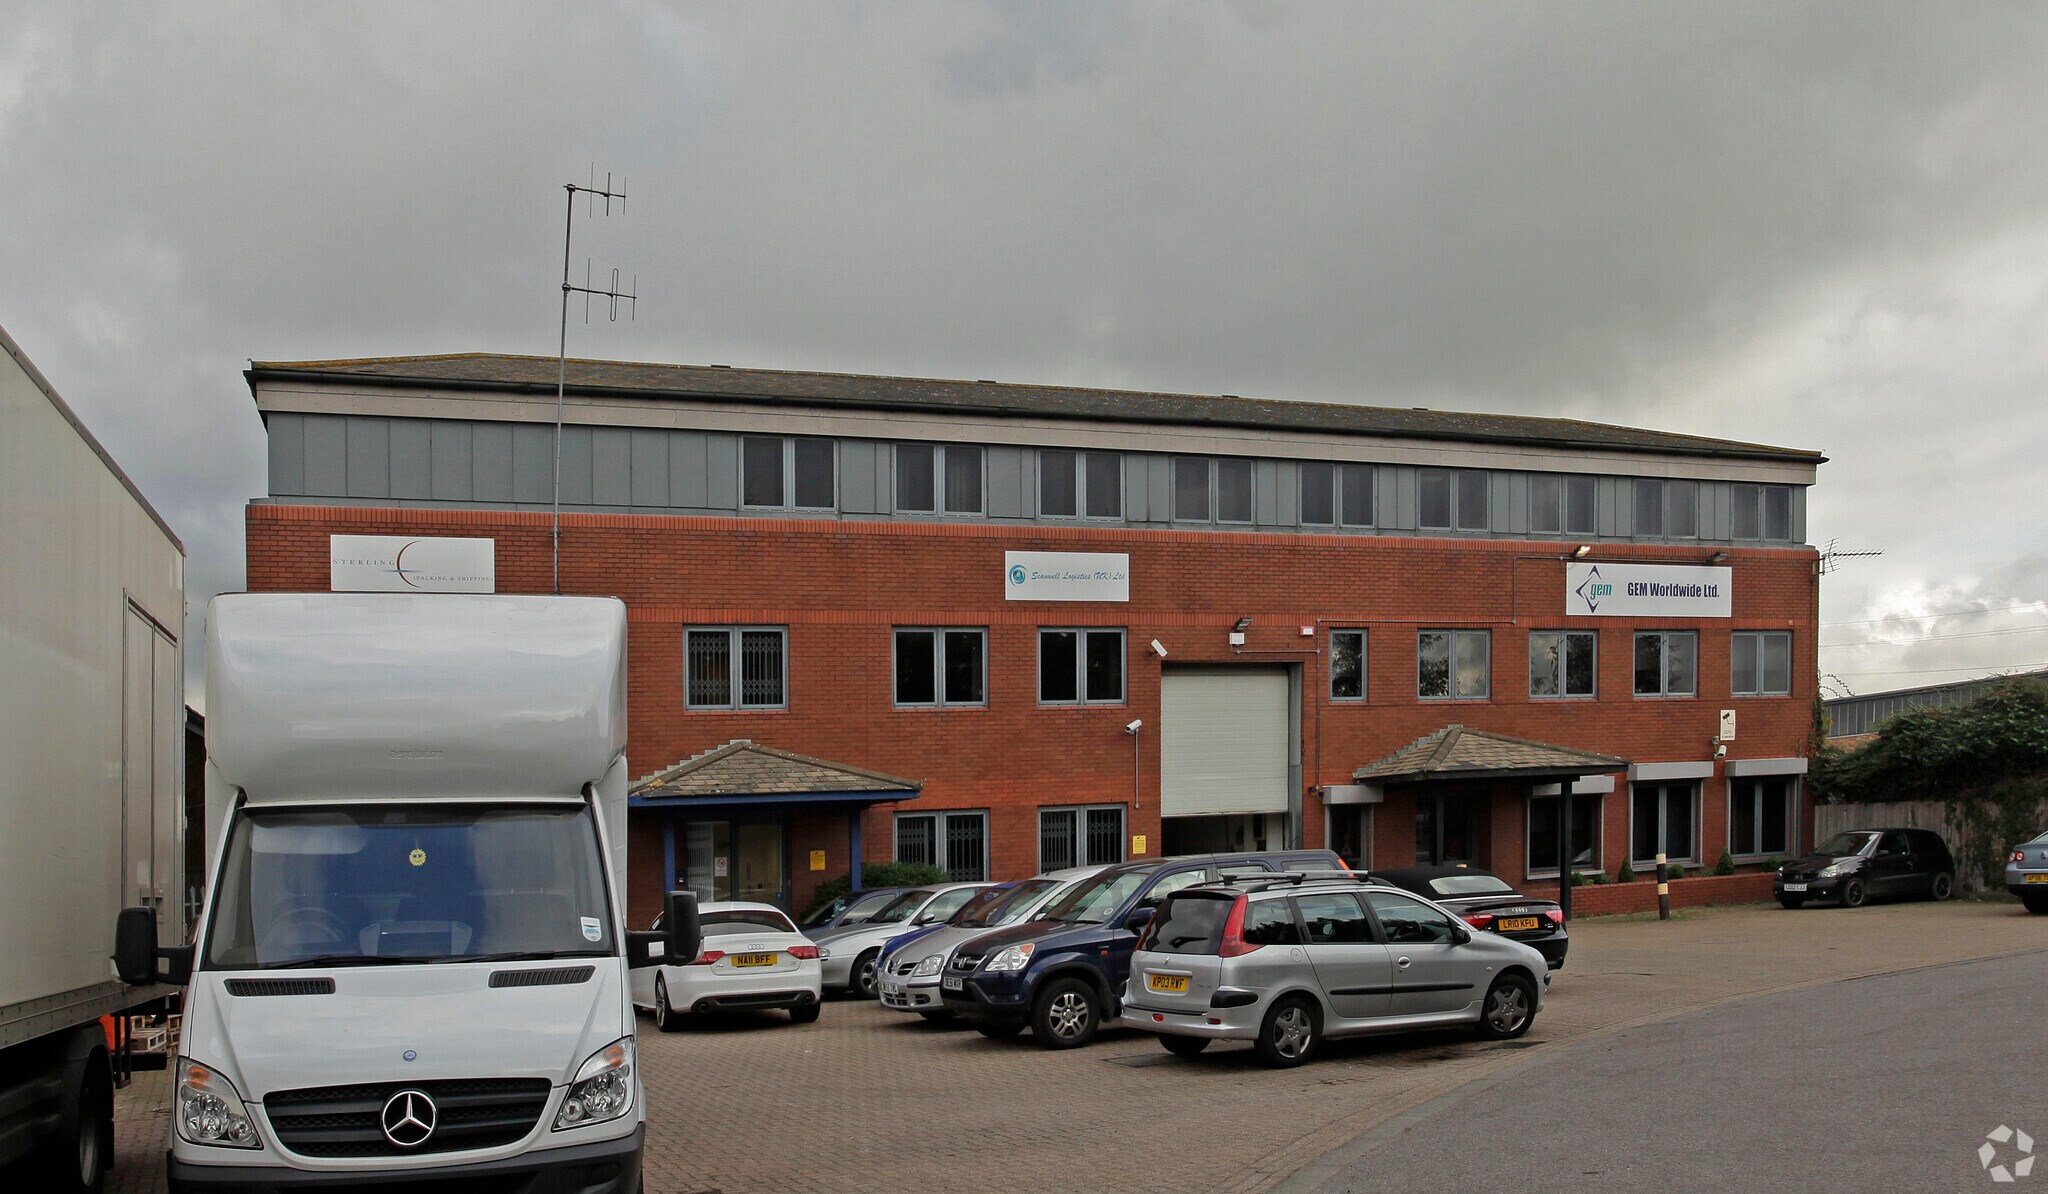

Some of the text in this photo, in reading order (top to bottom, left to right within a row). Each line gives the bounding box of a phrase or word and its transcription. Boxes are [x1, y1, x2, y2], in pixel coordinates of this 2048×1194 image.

[1062, 571, 1090, 582] Logistics
[1113, 571, 1126, 580] Ltd
[1590, 583, 1612, 600] gem
[1627, 582, 1720, 598] GEM Worldwide Ltd.
[1520, 918, 1534, 927] KFU
[755, 954, 771, 964] BFF
[1152, 976, 1169, 988] KP03
